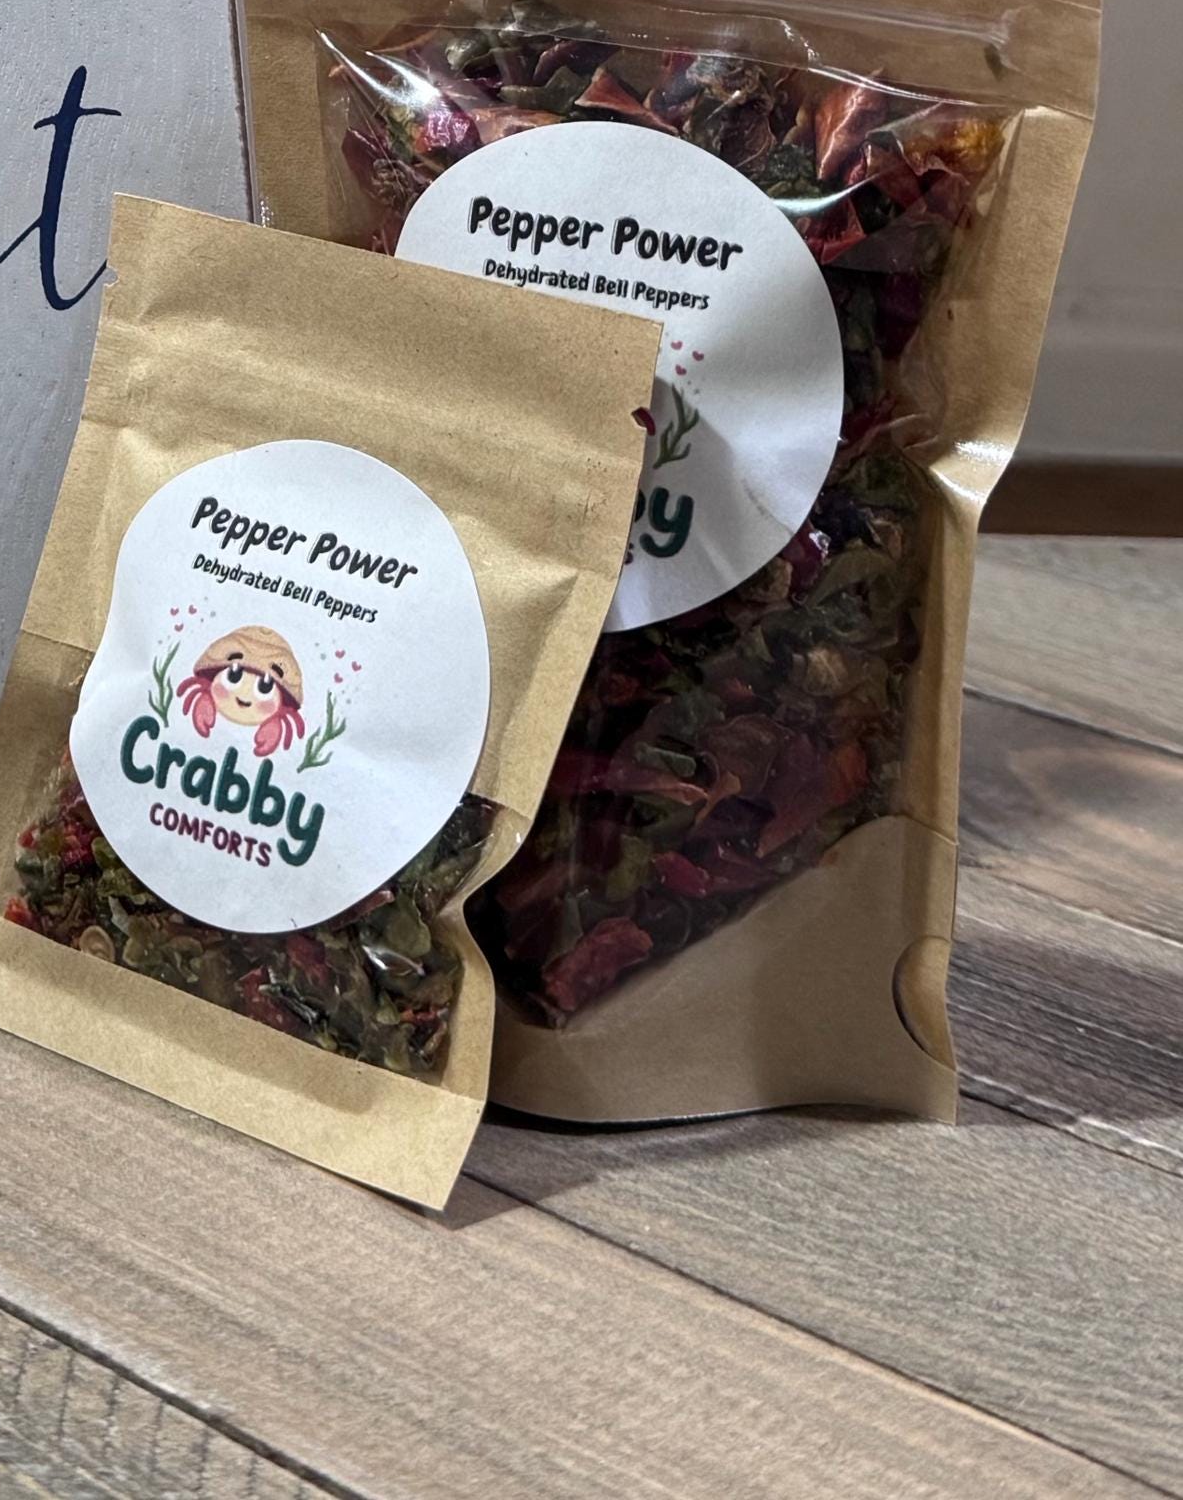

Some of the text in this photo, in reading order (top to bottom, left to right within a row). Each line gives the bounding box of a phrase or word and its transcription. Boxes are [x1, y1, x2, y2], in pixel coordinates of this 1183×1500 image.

[467, 196, 744, 271] Pepper Power
[483, 258, 711, 311] Dehydrated Bell Peppers
[191, 496, 418, 589] Pepper Power
[192, 552, 378, 625] Dehydrated Bell Peppers
[120, 715, 326, 867] Crabby
[149, 802, 273, 868] COMFORTS
